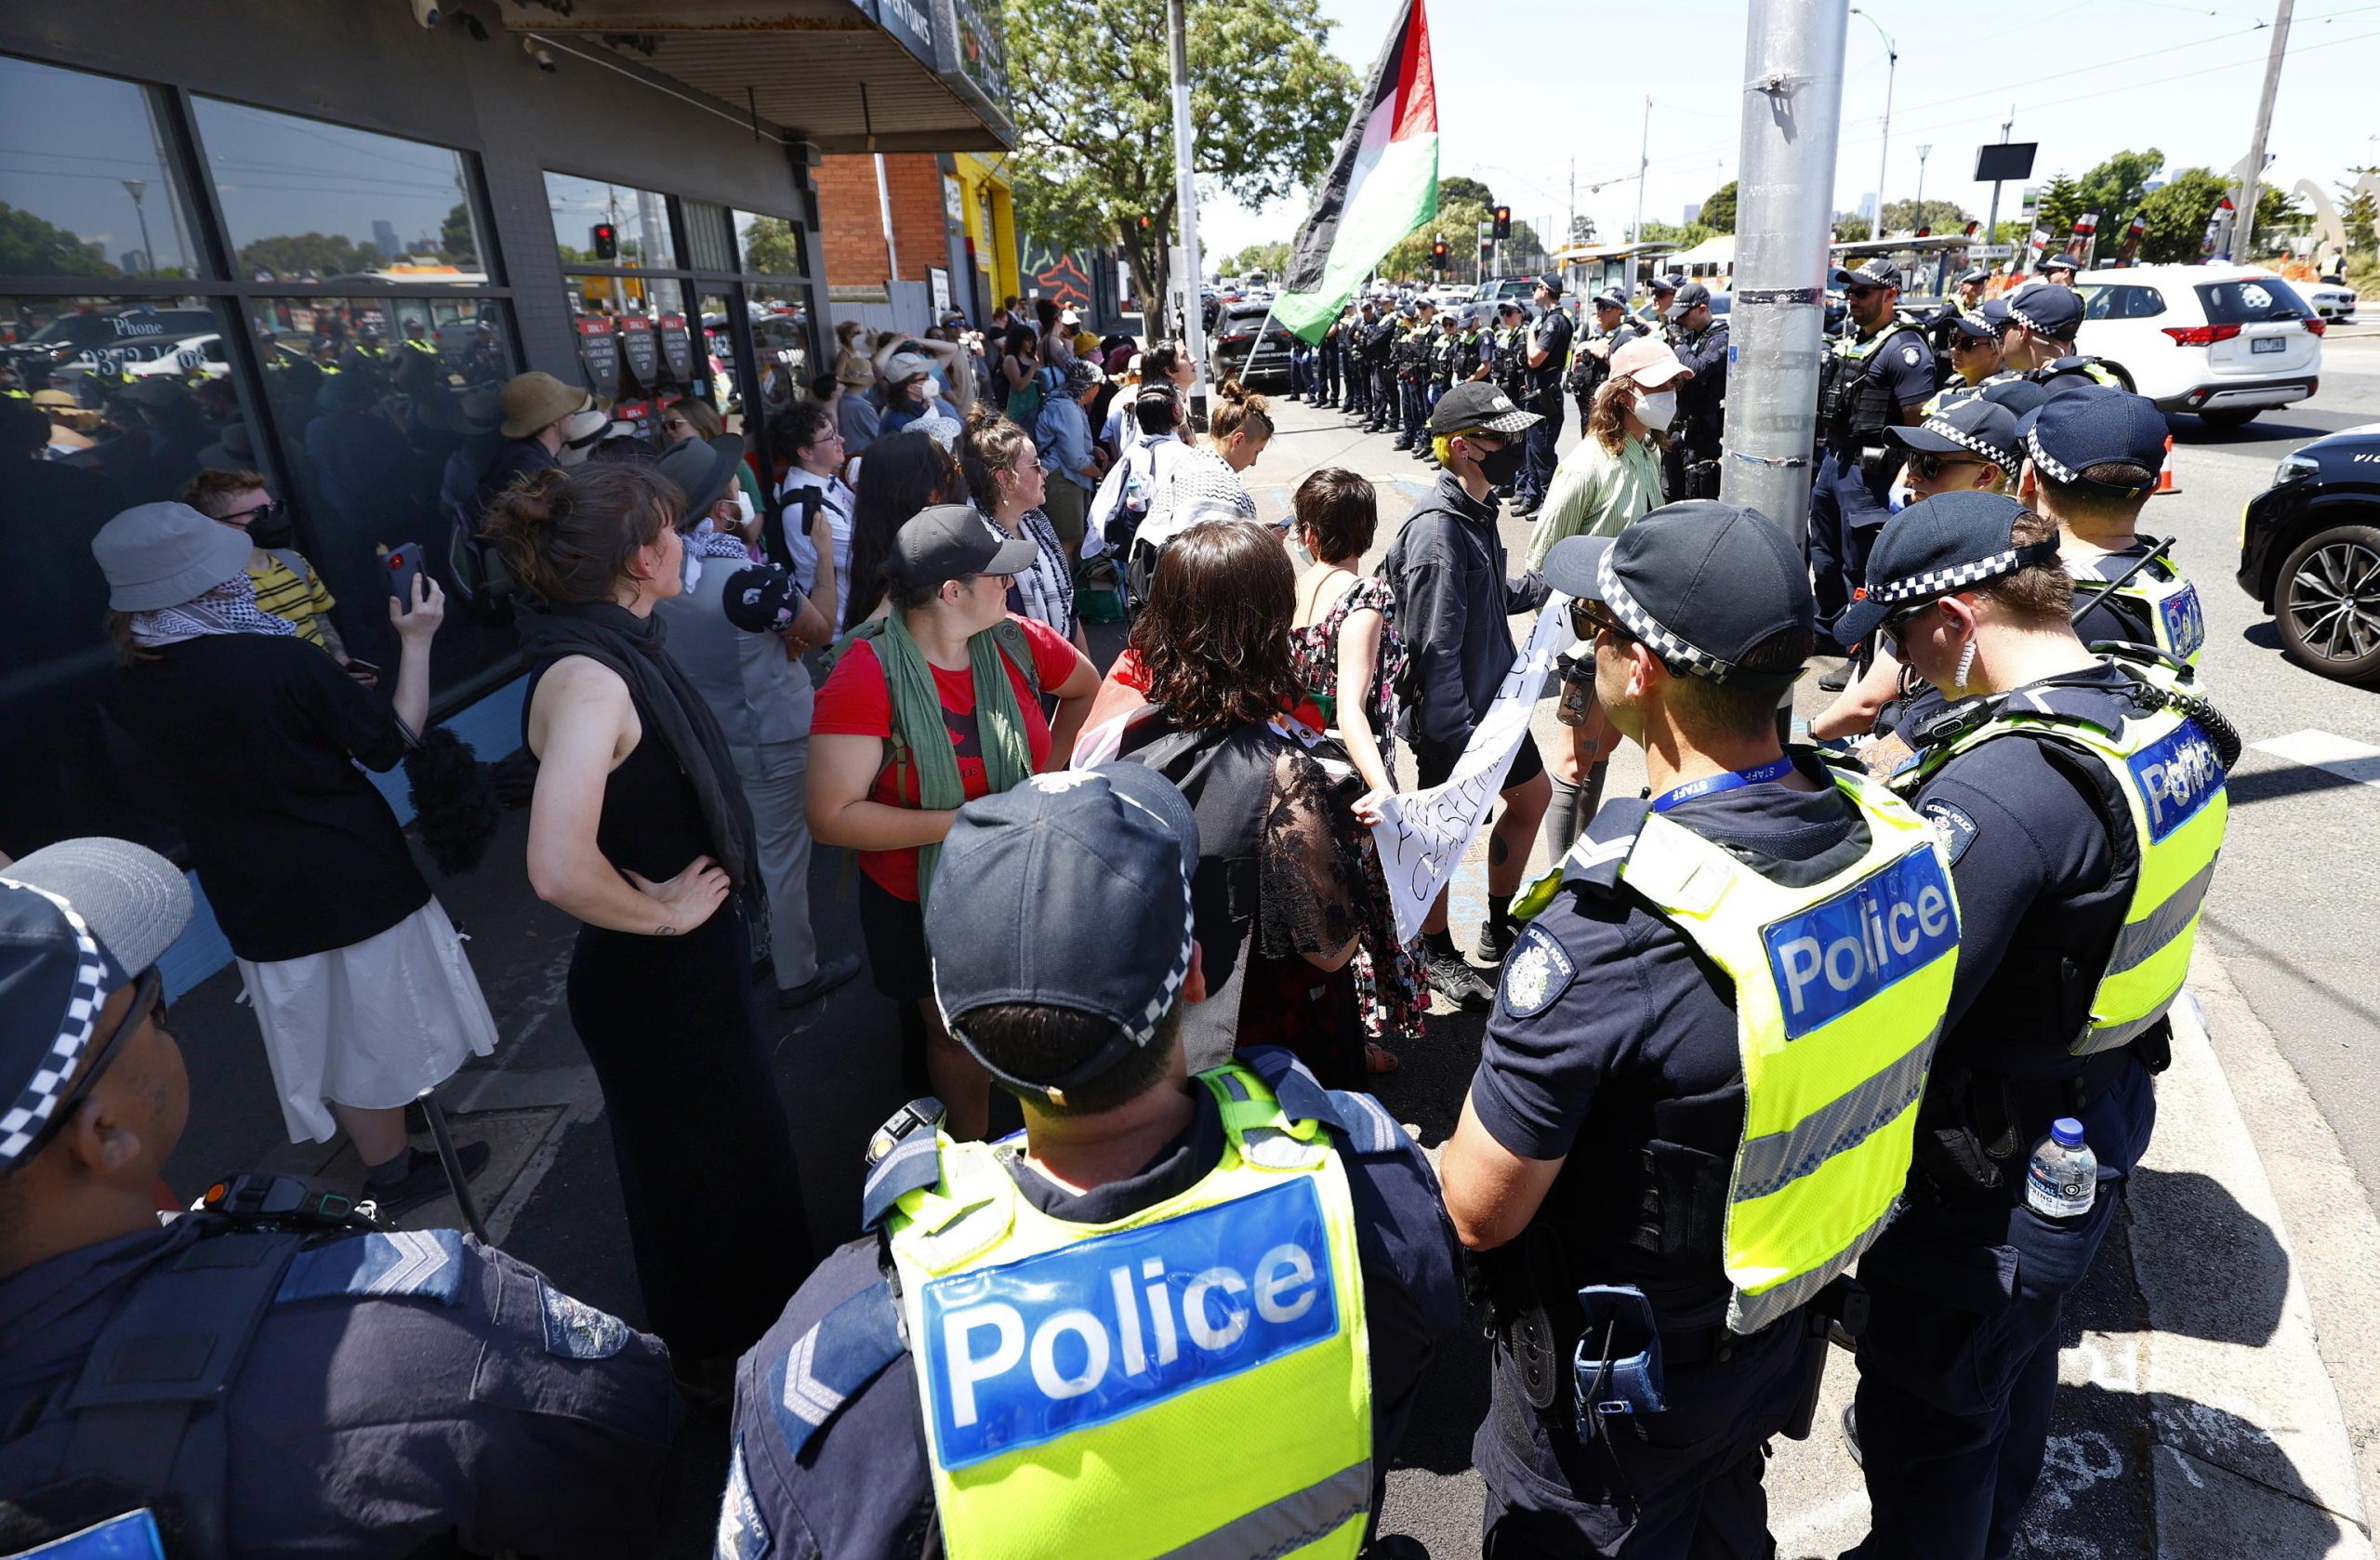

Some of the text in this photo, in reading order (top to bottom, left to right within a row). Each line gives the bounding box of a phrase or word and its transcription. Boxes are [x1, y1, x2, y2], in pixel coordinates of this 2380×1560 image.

[907, 2, 931, 46] DAYS
[113, 318, 164, 336] Phone
[1745, 767, 1775, 782] STAFF
[1673, 780, 1709, 801] STAFF
[1950, 813, 1974, 834] POLICE
[1549, 946, 1572, 977] POLICE
[1778, 884, 1949, 1015] Police
[943, 1243, 1318, 1430] Police
[743, 1495, 765, 1540] POLICE
